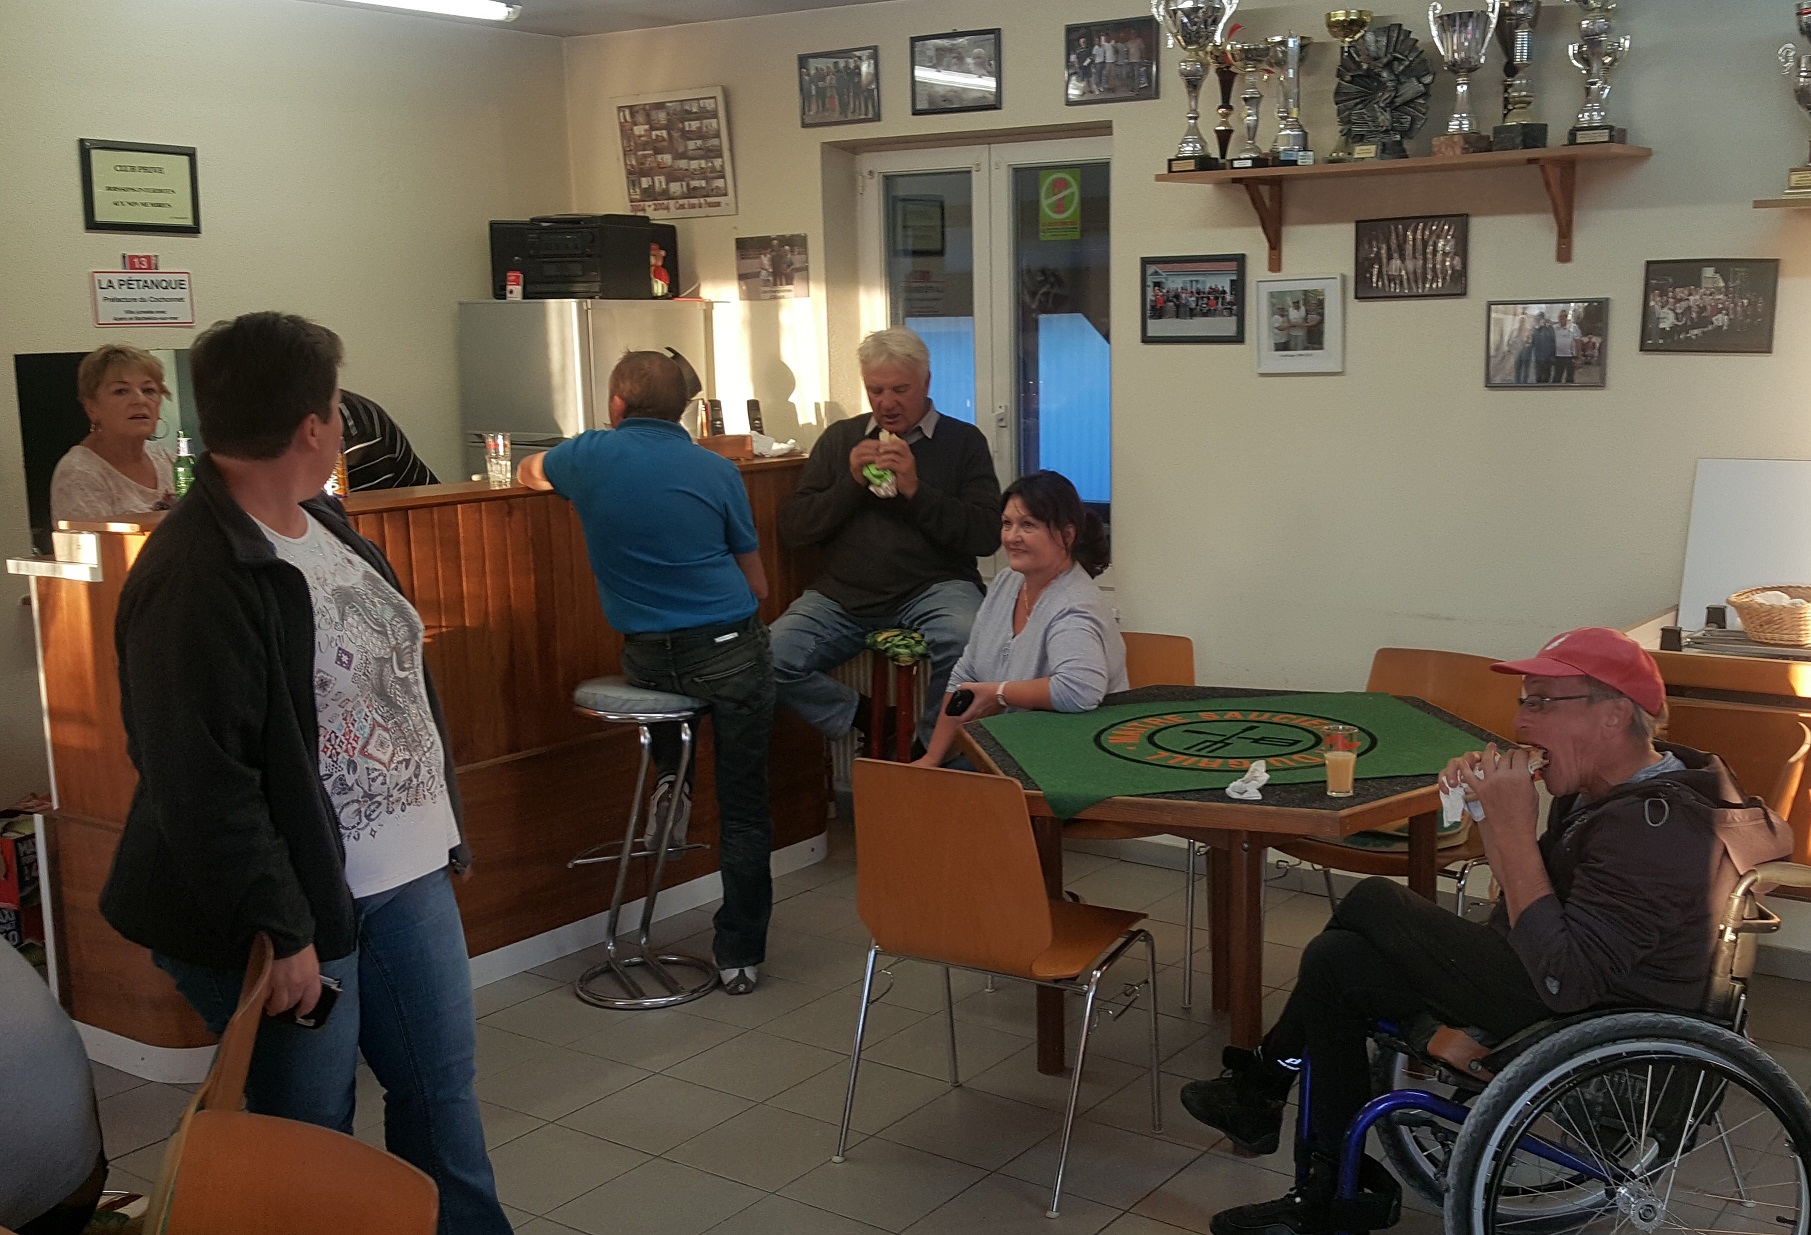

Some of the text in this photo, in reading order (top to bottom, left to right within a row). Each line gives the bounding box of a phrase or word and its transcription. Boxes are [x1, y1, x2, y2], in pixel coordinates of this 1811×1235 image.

[133, 257, 149, 269] 13
[97, 276, 187, 290] LA PÉTANQUE
[1145, 752, 1252, 769] GRILL
